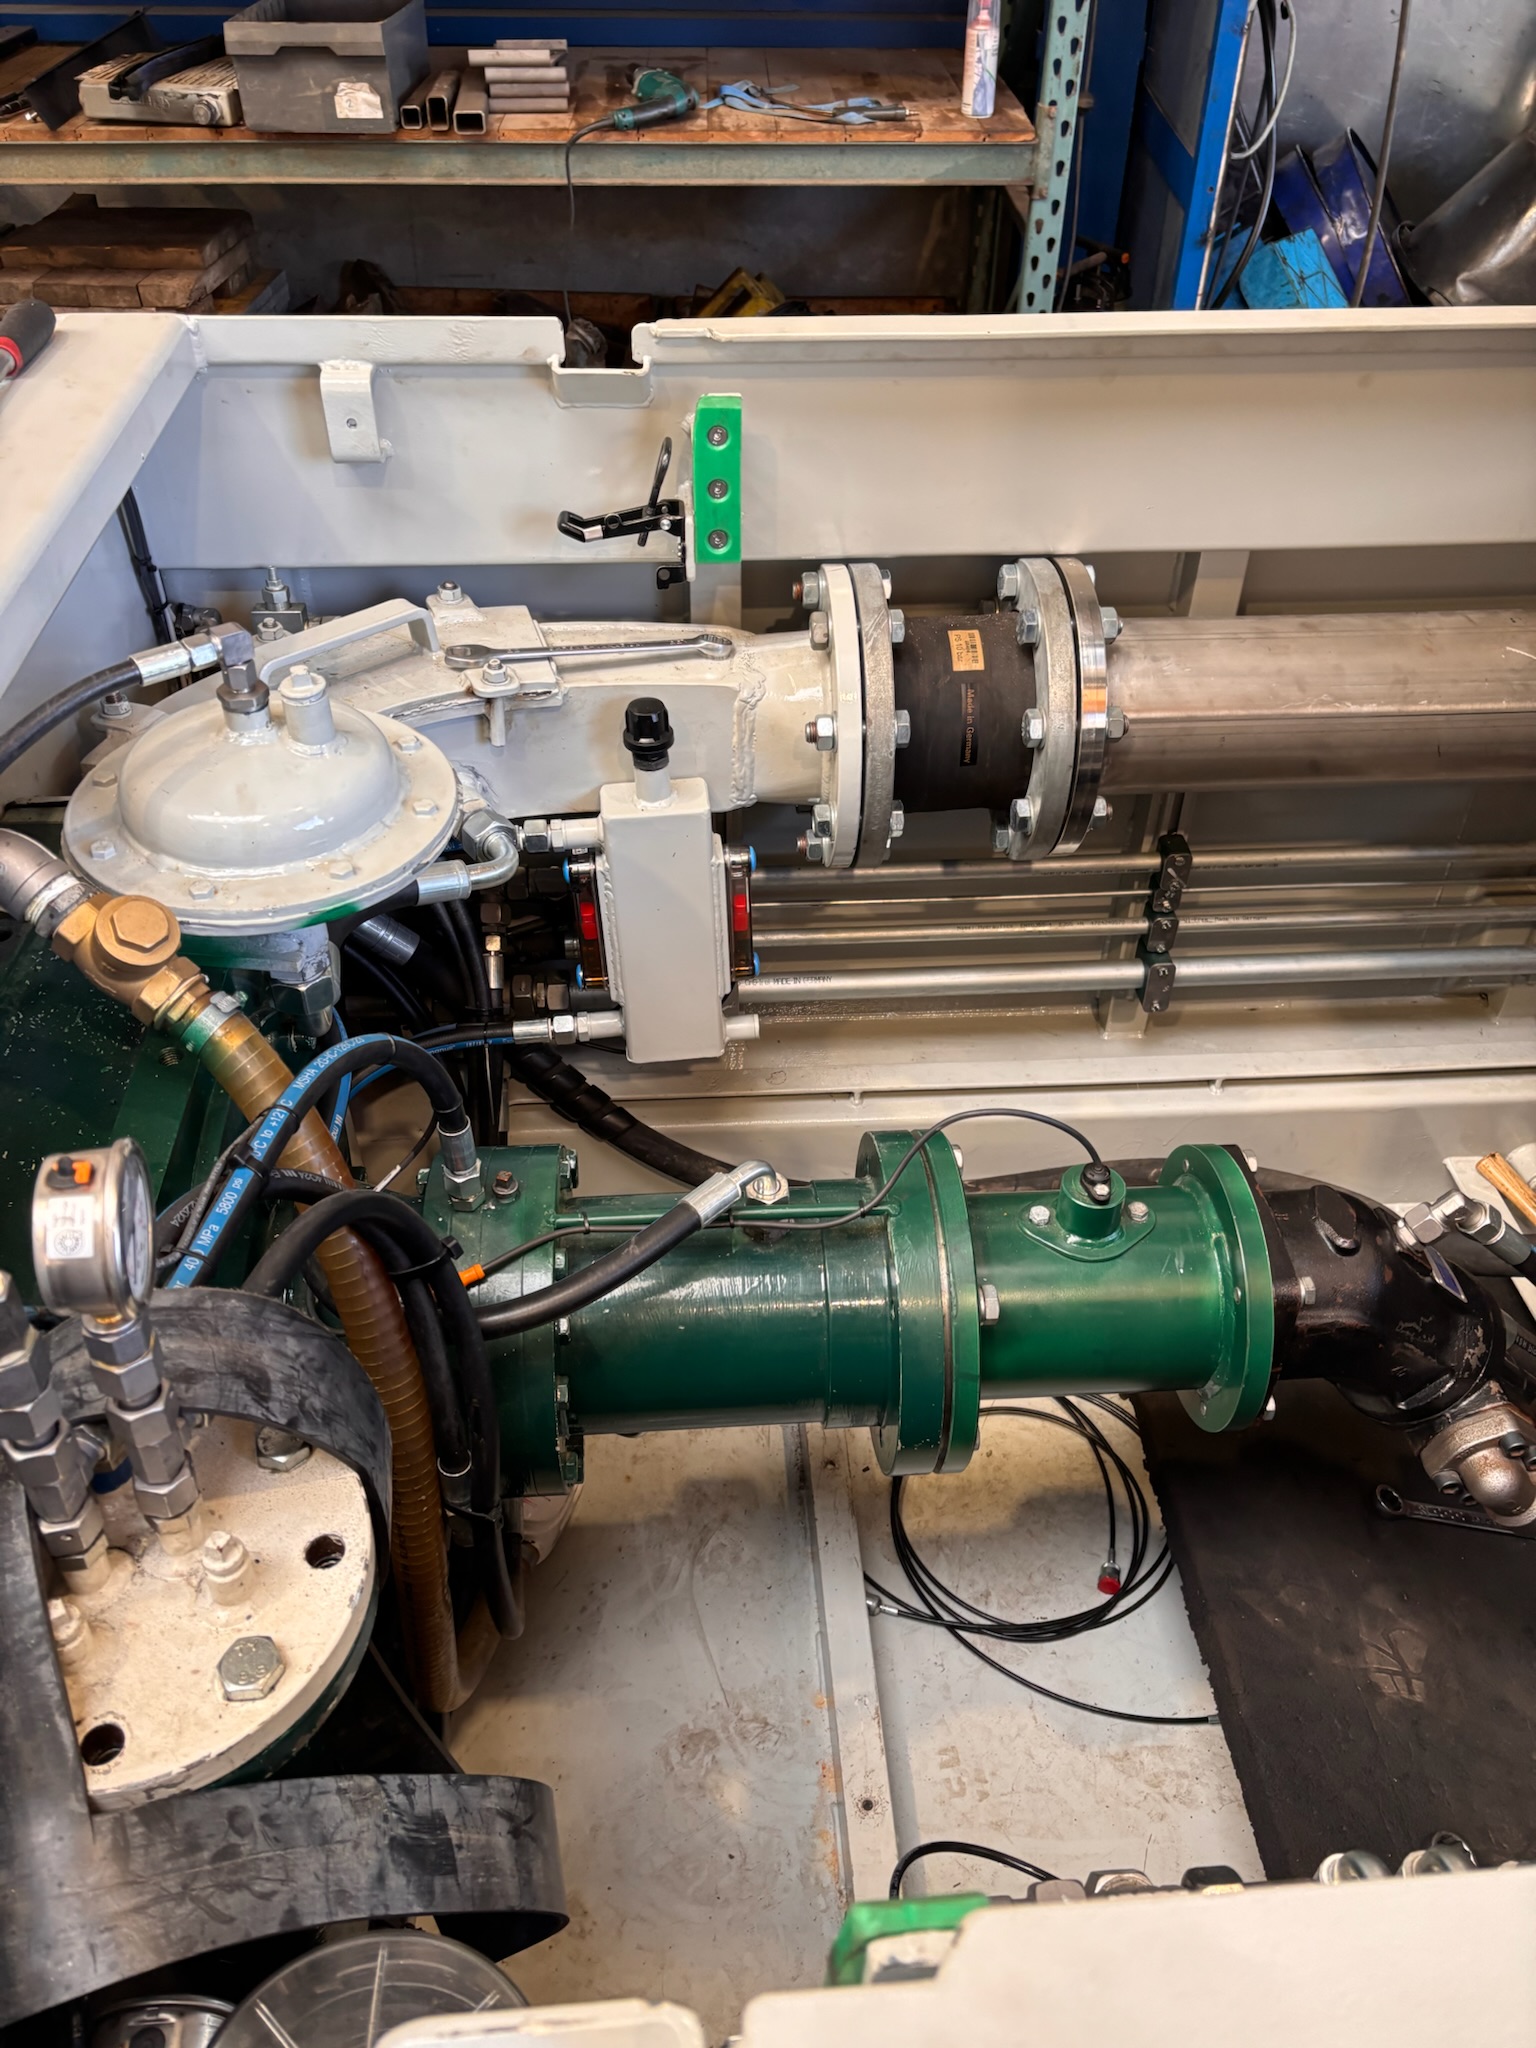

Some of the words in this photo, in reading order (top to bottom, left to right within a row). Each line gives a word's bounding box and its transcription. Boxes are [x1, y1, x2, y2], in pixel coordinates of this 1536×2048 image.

[966, 688, 975, 714] Made
[966, 716, 975, 724] in
[963, 726, 975, 764] Germany
[196, 1223, 221, 1247] MPa
[216, 1191, 238, 1215] 5800
[231, 1177, 244, 1190] psi
[260, 1129, 274, 1139] to
[292, 1068, 319, 1090] MSHA
